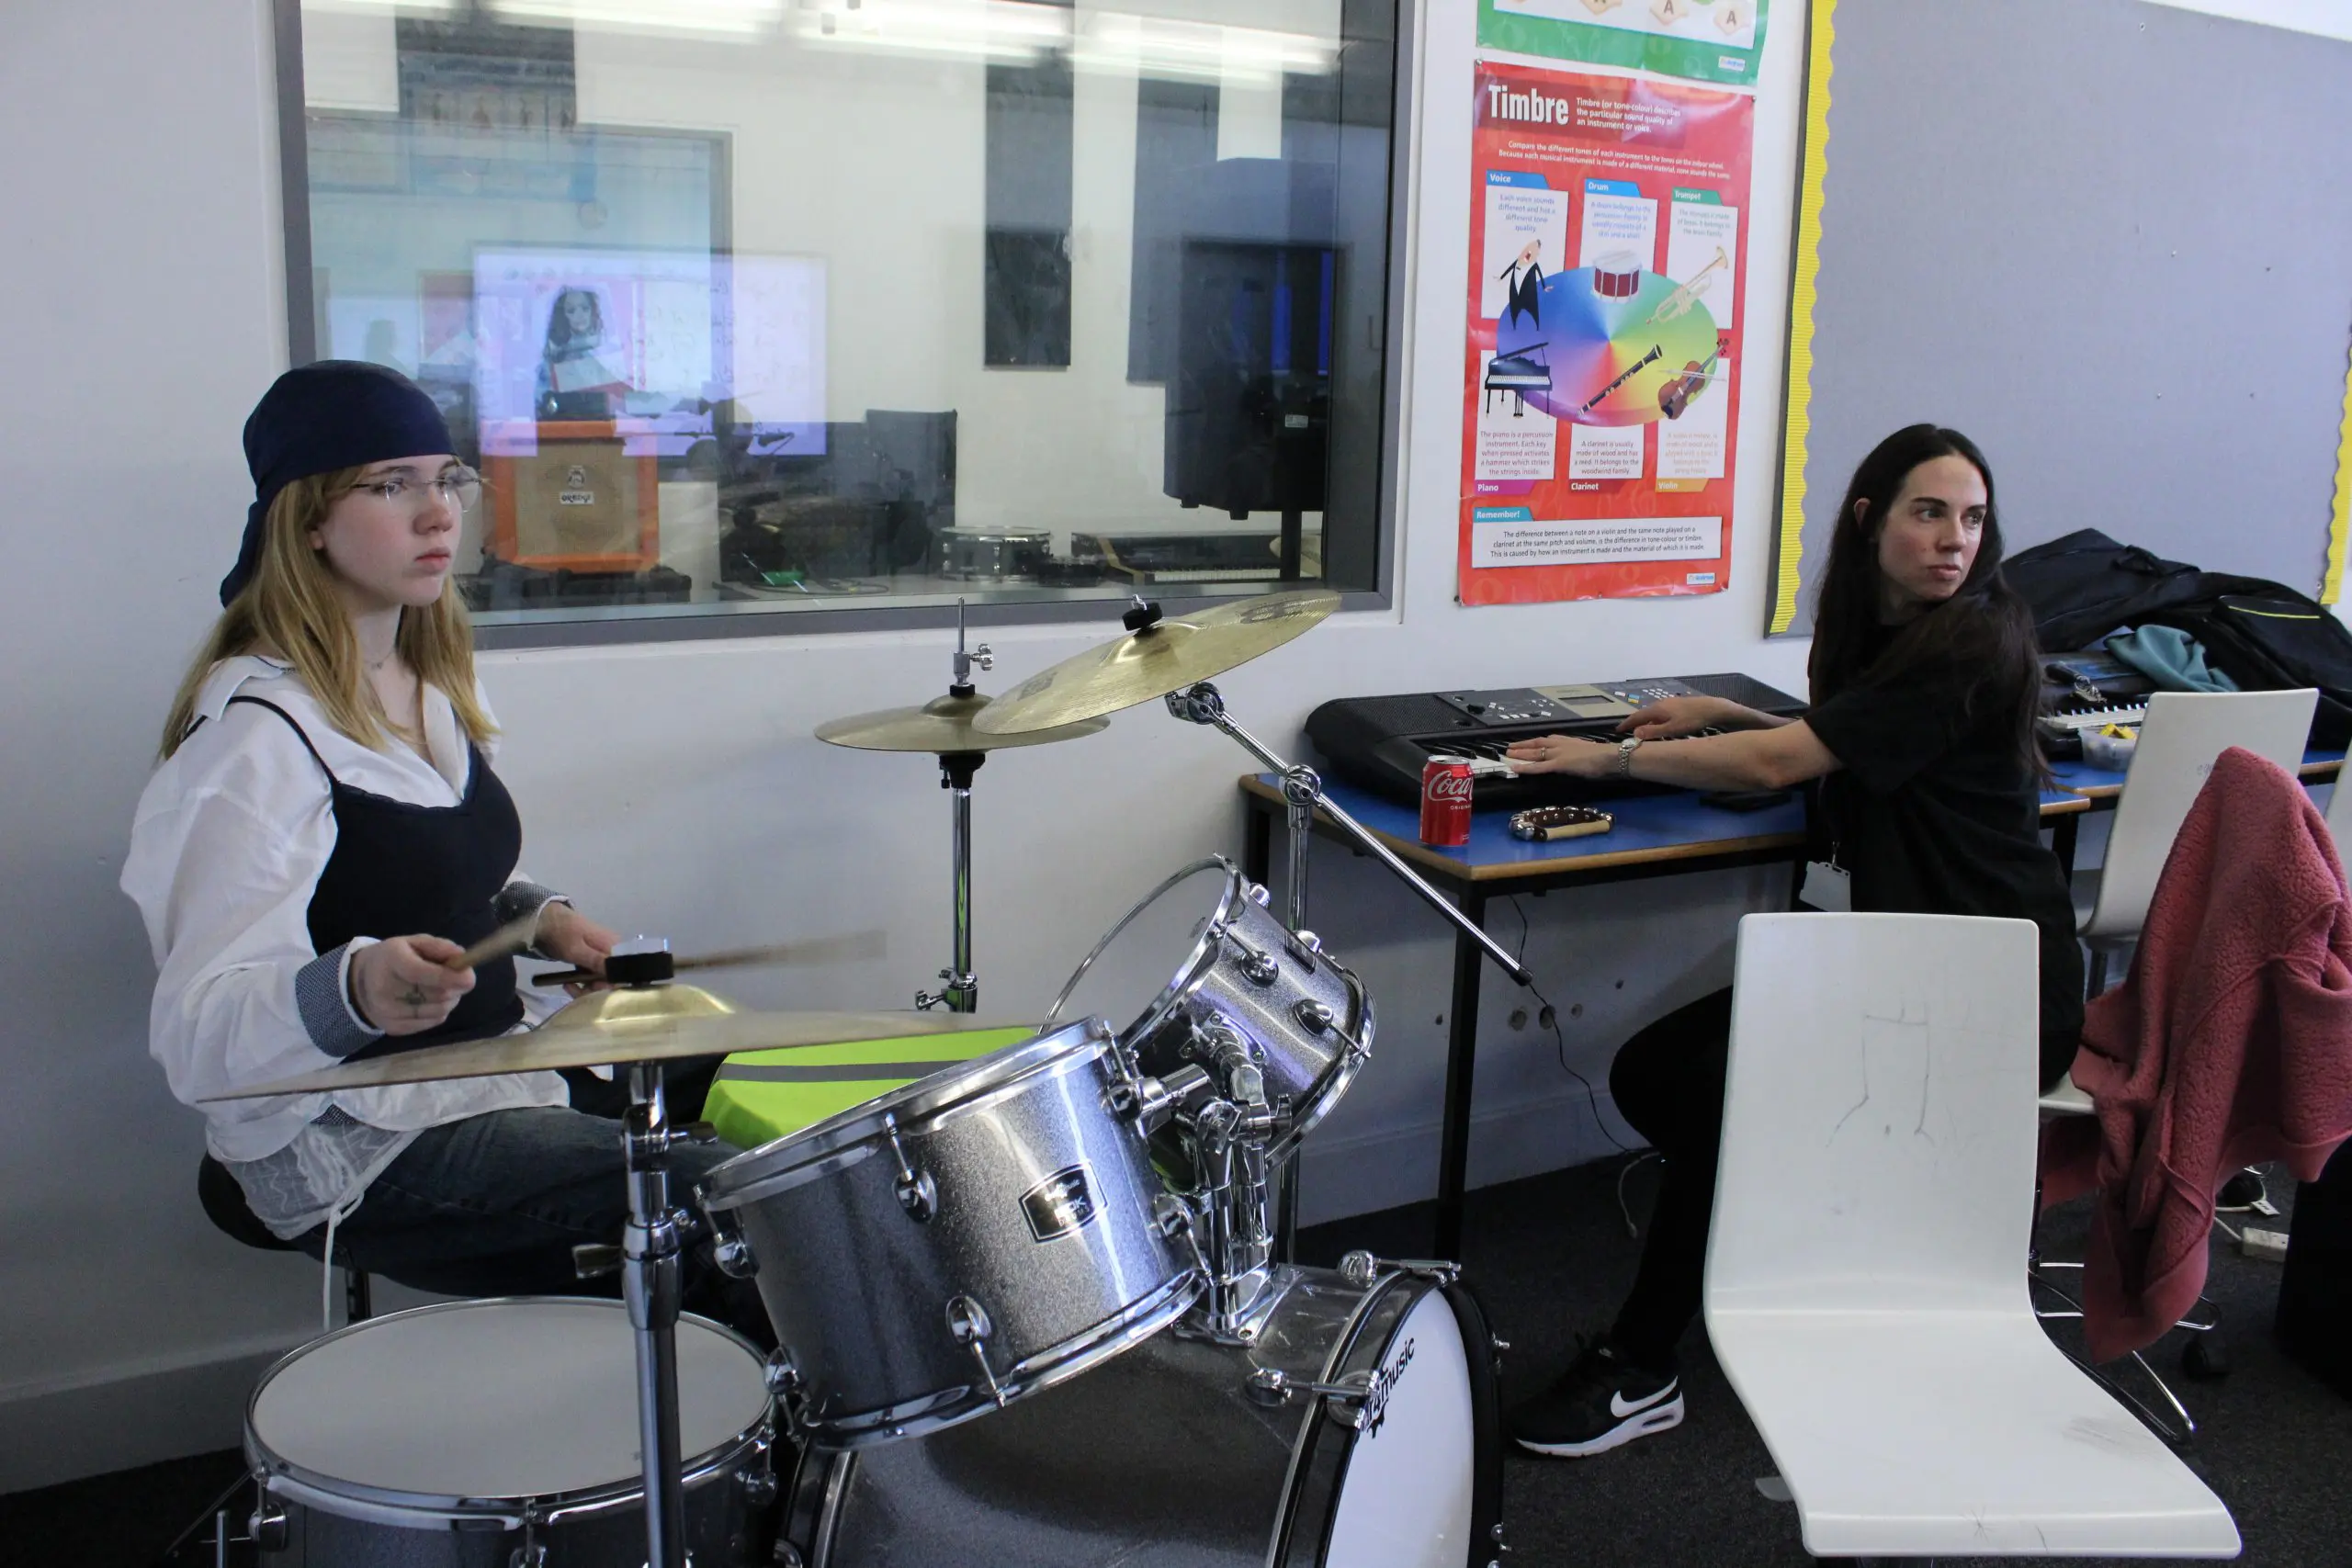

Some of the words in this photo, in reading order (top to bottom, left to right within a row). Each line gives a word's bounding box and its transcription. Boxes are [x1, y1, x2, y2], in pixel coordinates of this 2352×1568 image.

[1726, 10, 1736, 26] A
[1488, 85, 1569, 125] Timbre
[1577, 97, 1600, 107] Timbre
[1602, 99, 1612, 109] (or
[1614, 102, 1653, 113] tone-colour)
[1590, 110, 1622, 119] particular
[1624, 113, 1644, 121] sound
[1645, 115, 1665, 125] quality
[1588, 118, 1624, 130] instrument
[1634, 124, 1651, 133] voice.
[1508, 141, 1536, 151] Compare
[1537, 143, 1547, 151] the
[1548, 144, 1574, 153] different
[1615, 151, 1643, 160] instrument
[1498, 149, 1523, 158] Because
[1525, 152, 1538, 160] each
[1540, 153, 1562, 162] musical
[1563, 155, 1595, 165] instrument
[1629, 161, 1653, 171] different
[1490, 173, 1511, 183] Voice
[1589, 181, 1609, 191] Drum
[1675, 190, 1701, 201] Trumpet
[1498, 203, 1525, 212] different
[1615, 440, 1634, 449] usually
[1600, 459, 1622, 467] belongs
[1501, 468, 1521, 477] strings
[1477, 483, 1499, 492] Piano
[1571, 482, 1599, 491] Clarinet
[1658, 481, 1679, 490] Violin
[1477, 510, 1520, 519] Remember!
[1666, 526, 1683, 535] played
[1549, 539, 1563, 548] pitch
[1530, 549, 1537, 558] by
